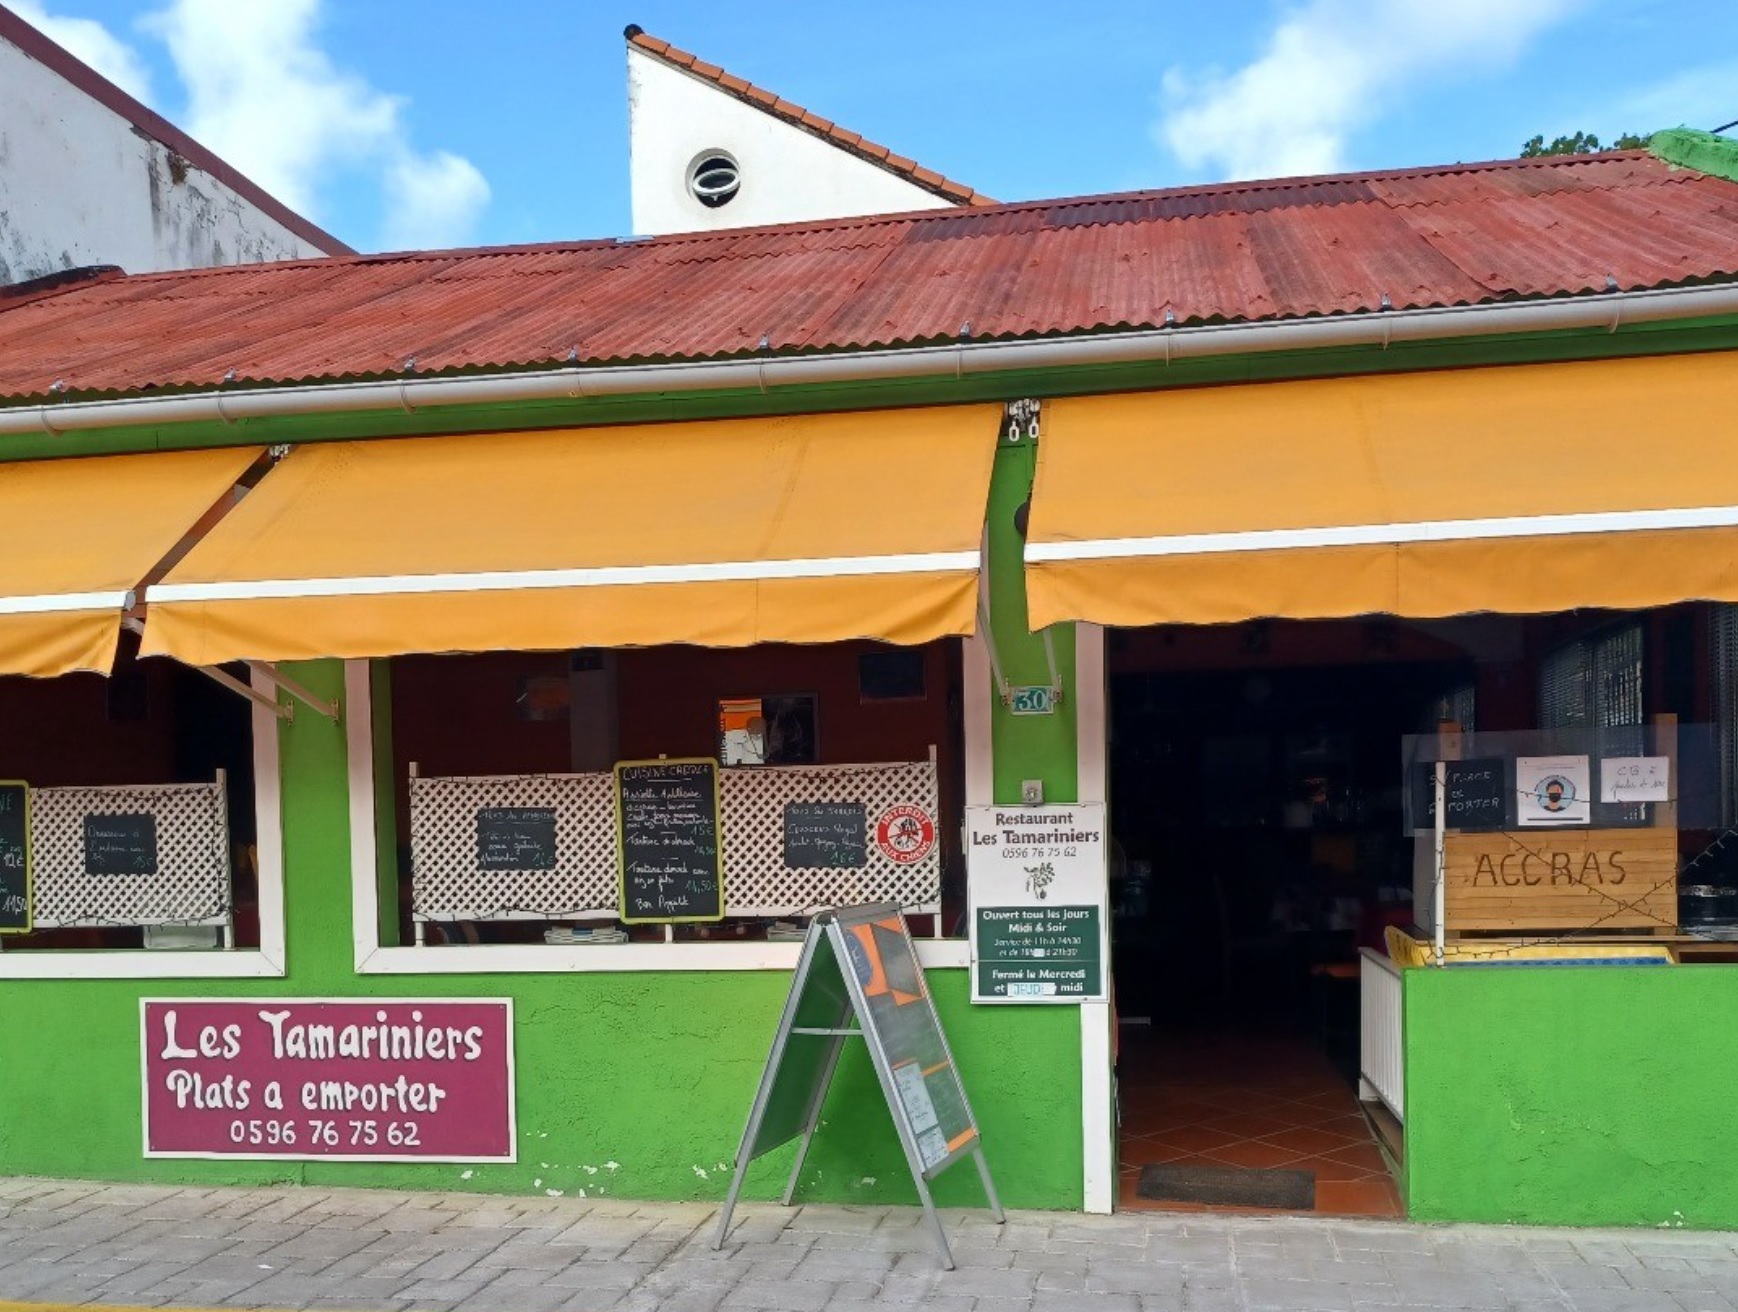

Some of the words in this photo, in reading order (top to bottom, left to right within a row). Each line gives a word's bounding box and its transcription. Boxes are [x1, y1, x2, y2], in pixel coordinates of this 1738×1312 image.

[1015, 690, 1047, 711] 30
[882, 806, 930, 826] INTERDIT
[994, 811, 1074, 827] Restaurant
[972, 830, 998, 846] Les
[1001, 828, 1100, 845] Tamariniers
[881, 842, 899, 859] AUX
[900, 841, 932, 861] CHIENS
[1001, 846, 1029, 859] 0596
[1031, 846, 1045, 858] 76
[1047, 846, 1061, 857] 75
[1063, 845, 1077, 857] 62
[1472, 851, 1626, 888] ACCRAS
[982, 910, 1020, 921] Ouvert
[1021, 909, 1045, 919] tous
[1047, 908, 1061, 919] les
[1062, 908, 1090, 921] jours
[1008, 922, 1033, 934] Midi
[1034, 922, 1045, 933] &
[1046, 921, 1068, 933] Soir
[1008, 947, 1019, 956] de
[992, 969, 1025, 980] Fermé
[1026, 969, 1036, 979] le
[1038, 968, 1087, 979] Mercredi
[993, 982, 1006, 994] et
[1060, 982, 1083, 992] midi
[160, 1009, 243, 1060] Les
[257, 1009, 484, 1061] Tamariniers
[165, 1068, 252, 1110] Plats
[263, 1080, 284, 1110] a
[300, 1074, 447, 1114] emporter
[229, 1119, 297, 1146] 0596
[308, 1120, 339, 1146] 76
[348, 1120, 379, 1146] 75
[386, 1121, 422, 1147] 62
